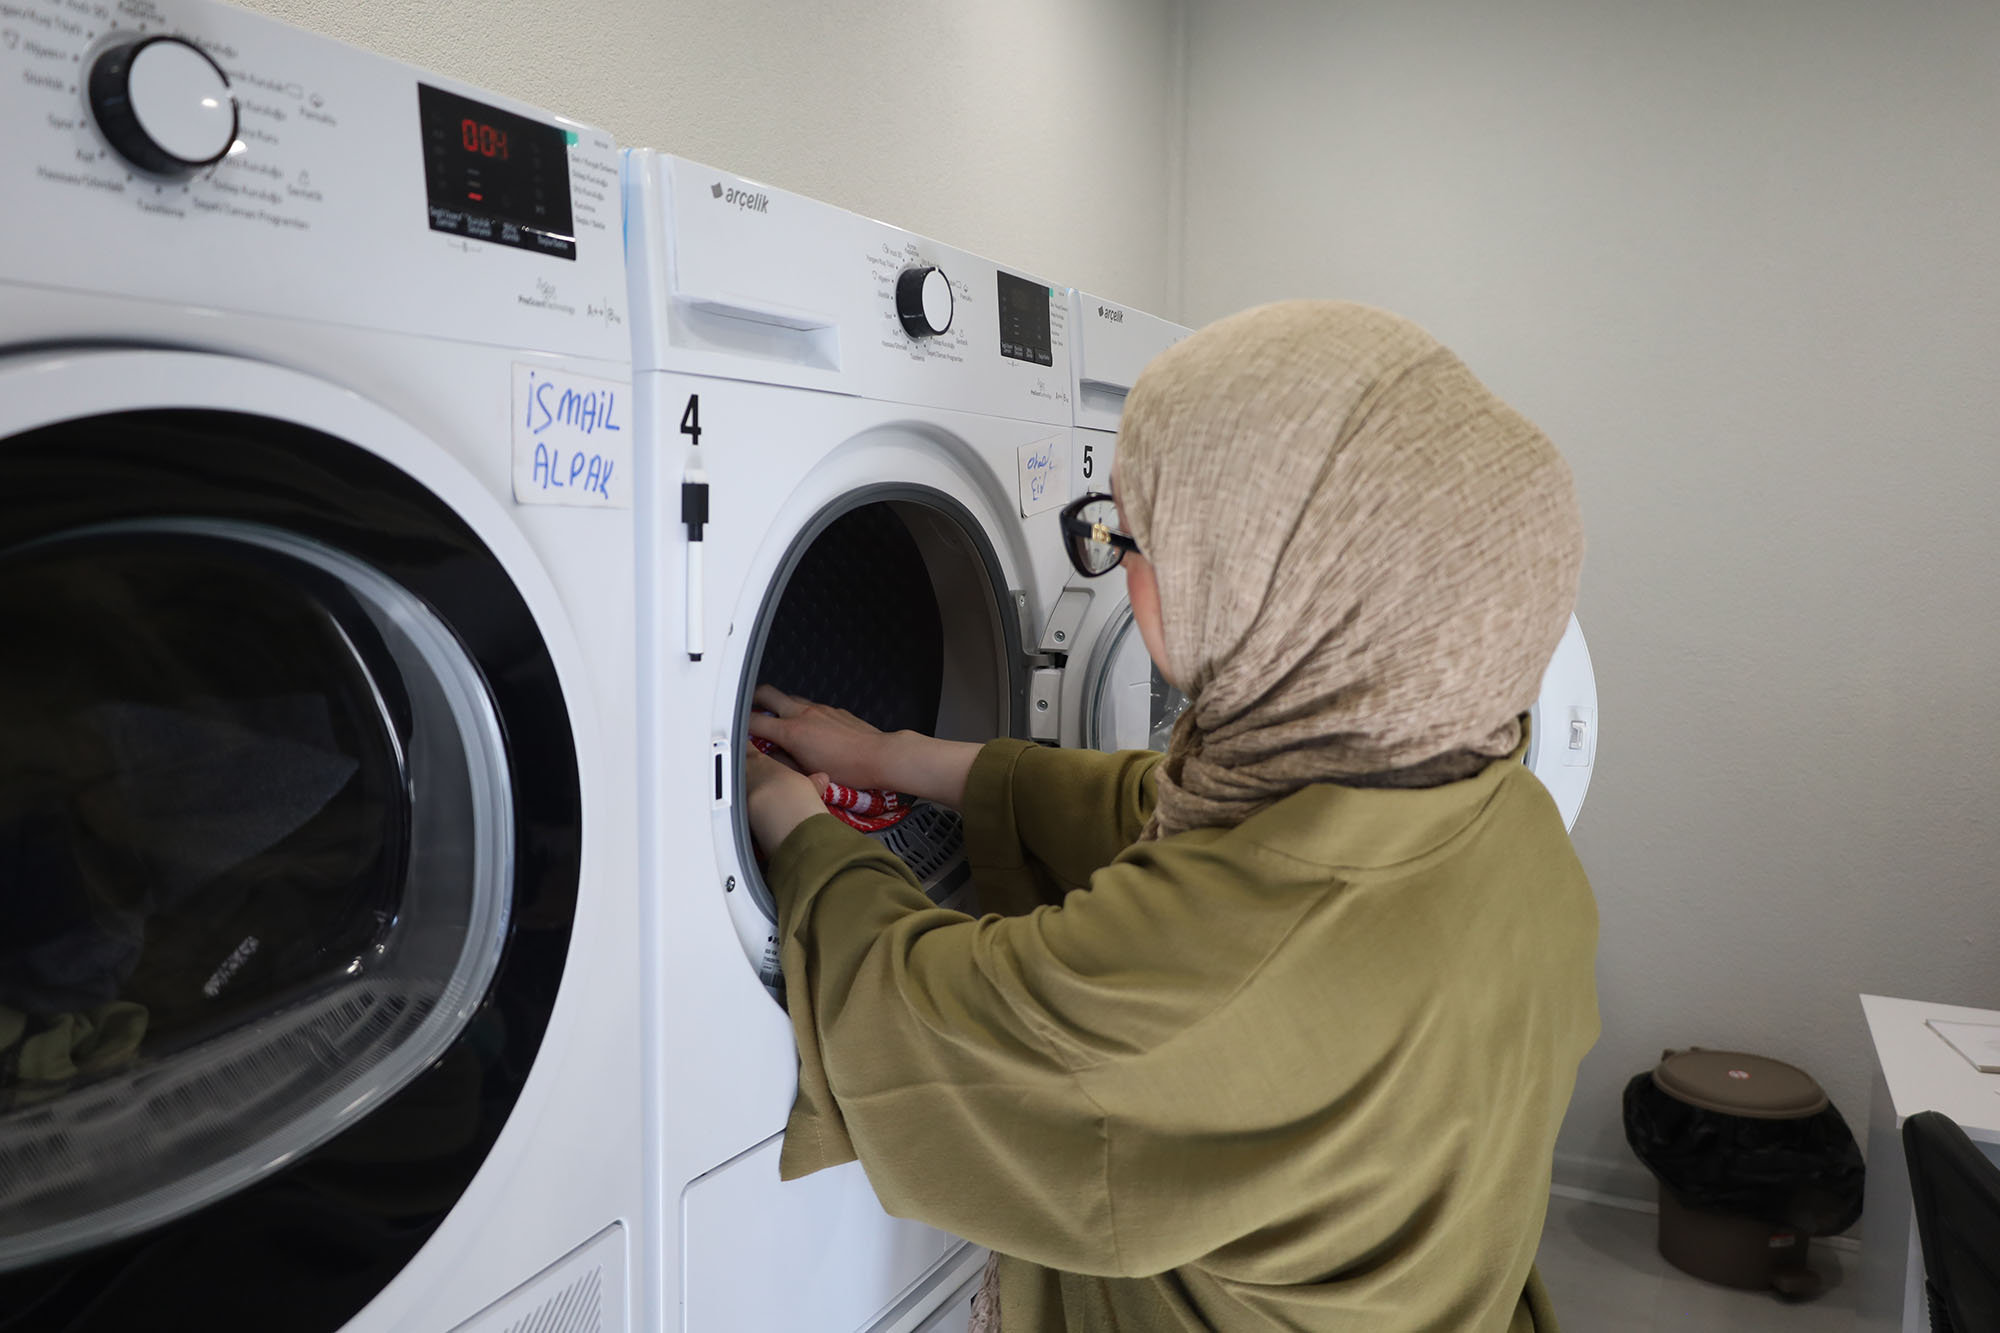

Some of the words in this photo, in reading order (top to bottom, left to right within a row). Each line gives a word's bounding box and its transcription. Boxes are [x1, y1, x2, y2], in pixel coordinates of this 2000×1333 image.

[725, 187, 769, 214] arçelik
[1104, 308, 1124, 323] arçelik
[680, 393, 702, 446] 4
[1083, 445, 1093, 479] 5
